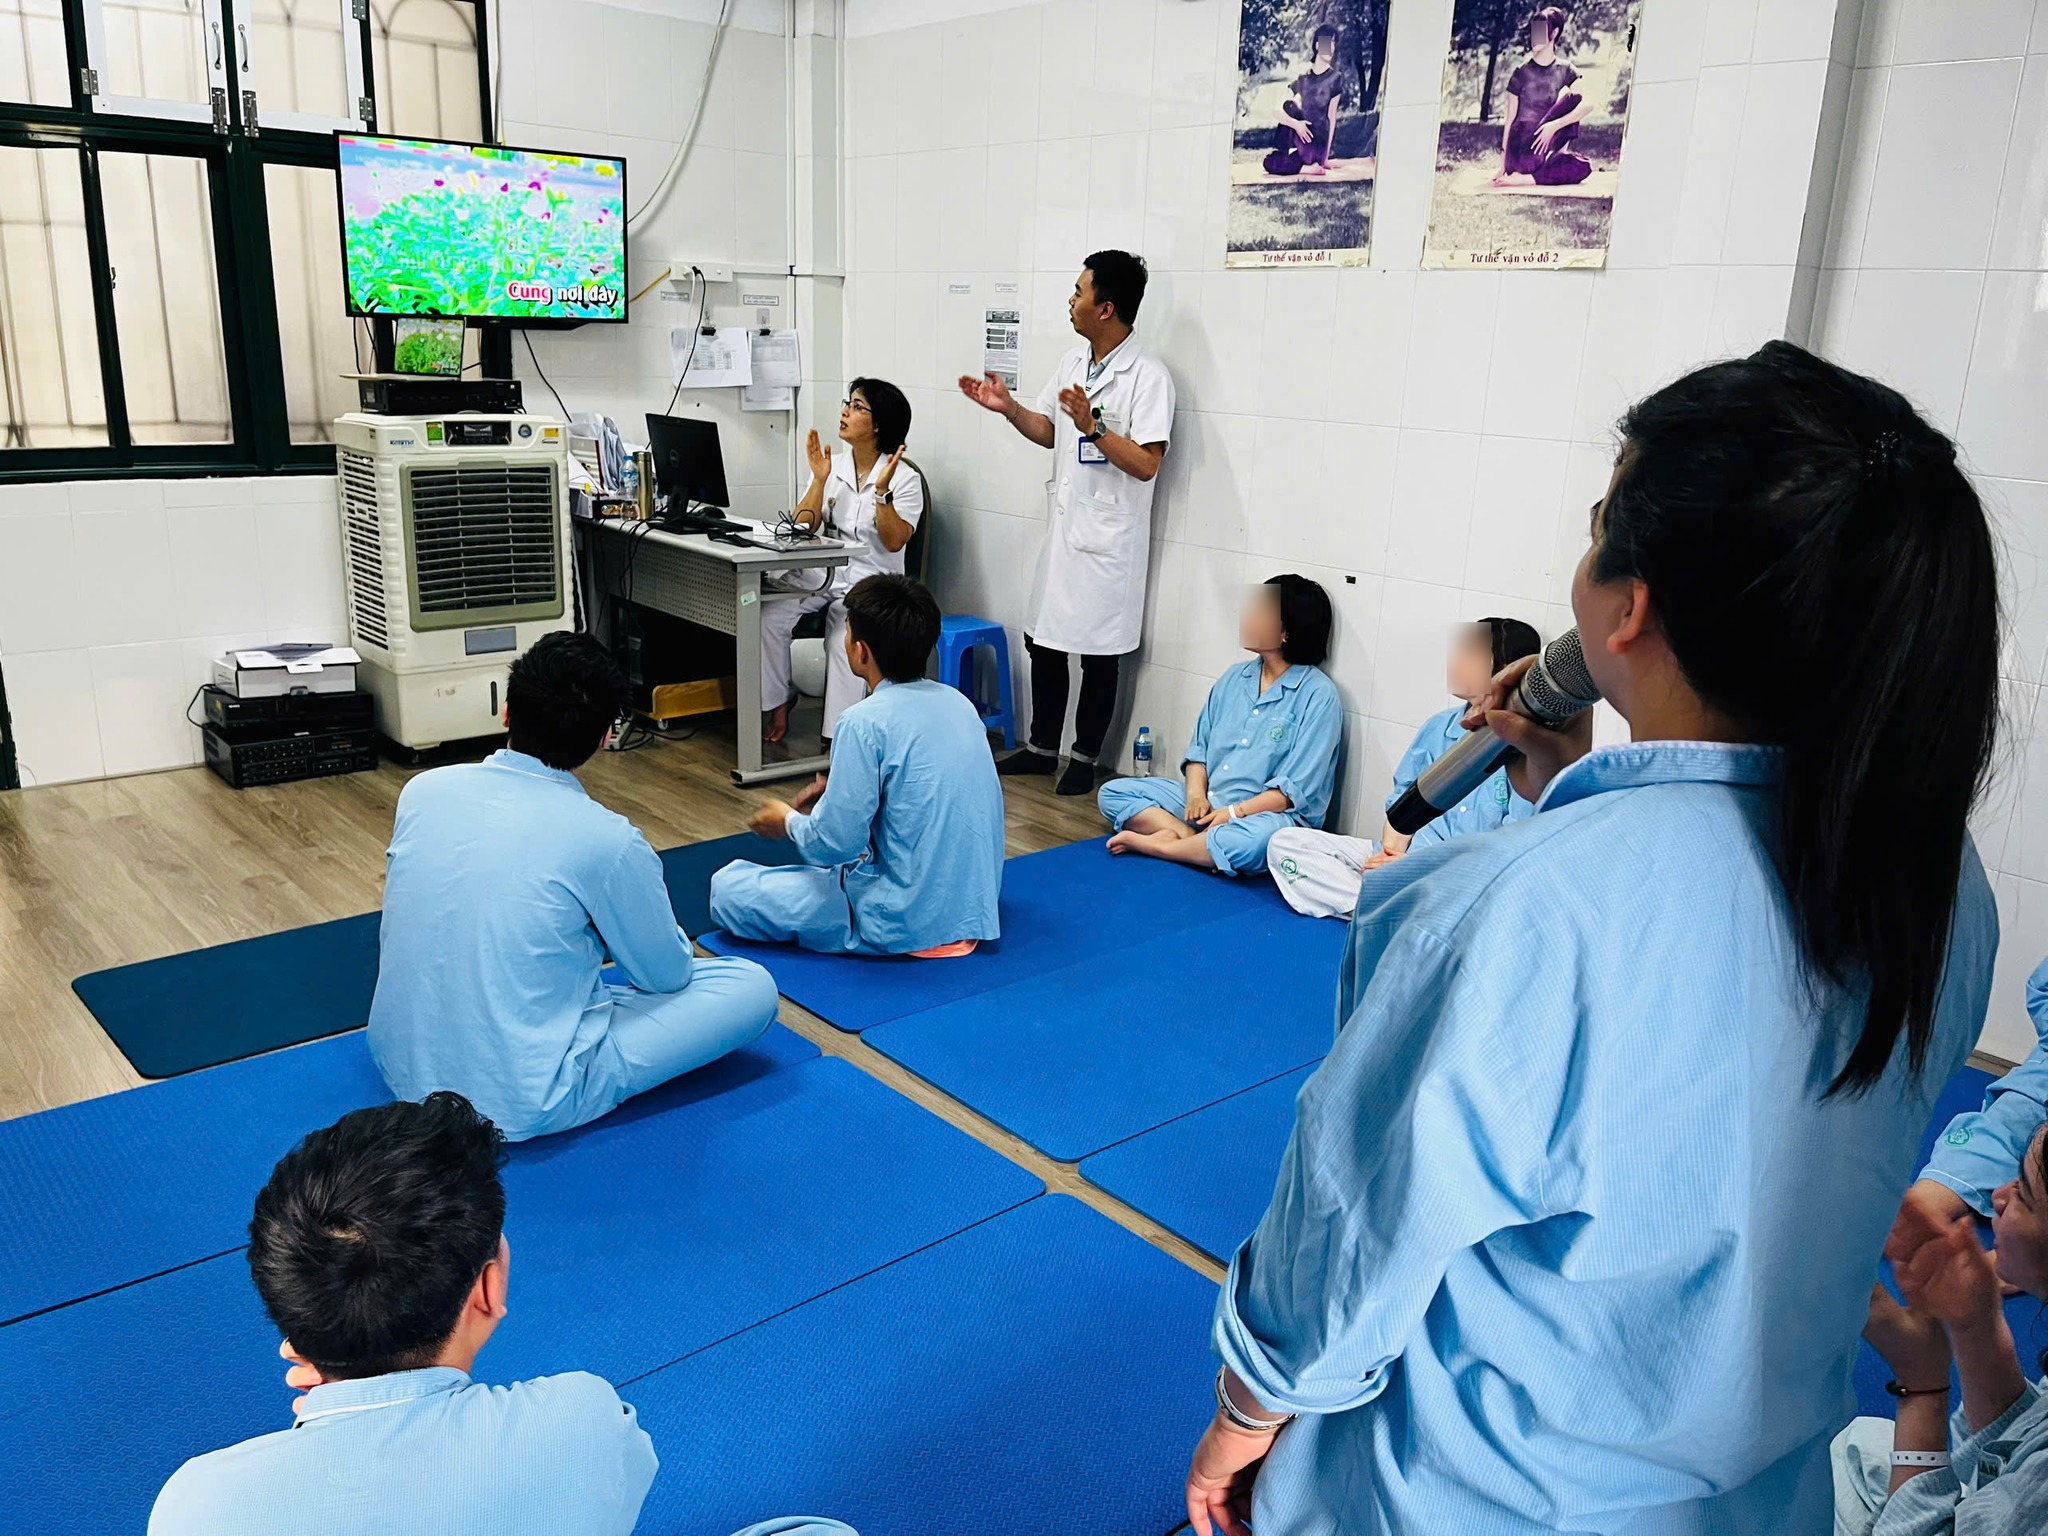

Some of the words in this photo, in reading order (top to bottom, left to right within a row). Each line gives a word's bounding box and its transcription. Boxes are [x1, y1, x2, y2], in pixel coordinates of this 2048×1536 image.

[1274, 252, 1286, 262] thế
[1471, 254, 1483, 262] Tư
[1523, 252, 1534, 262] vỏ
[1553, 253, 1559, 262] 2
